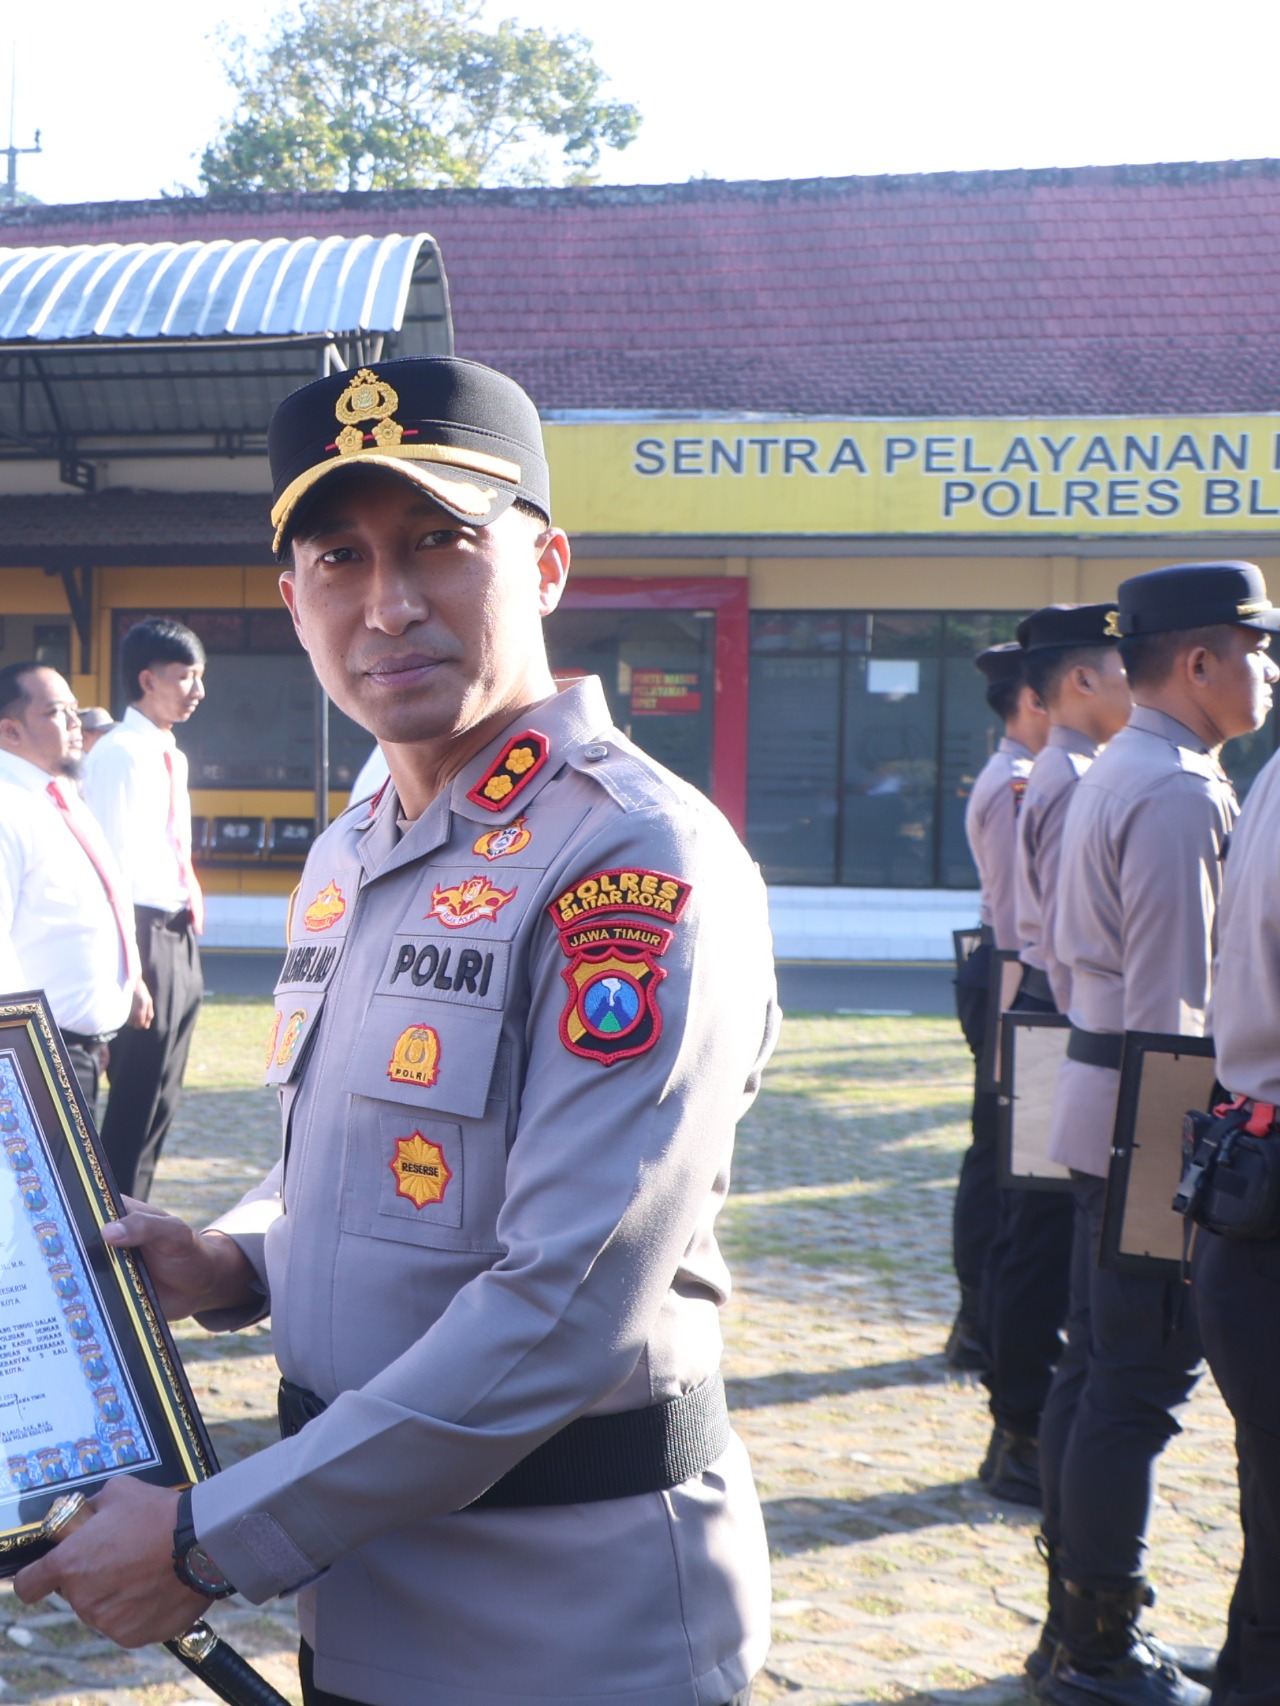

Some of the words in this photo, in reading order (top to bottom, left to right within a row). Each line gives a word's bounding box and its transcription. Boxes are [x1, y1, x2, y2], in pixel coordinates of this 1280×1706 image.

[634, 437, 868, 476] SENTRA
[884, 434, 1249, 475] PELAYANAN
[943, 480, 1181, 518] POLRES
[559, 873, 679, 911] POLRES
[561, 891, 623, 922] BLITAR
[626, 890, 673, 913] KOTA
[570, 928, 610, 947] JAWA
[613, 928, 661, 946] TIMUR
[389, 944, 494, 997] POLRI
[395, 1067, 427, 1082] POLRI
[401, 1162, 440, 1178] RESERSE
[0, 1297, 20, 1307] KOTA
[34, 1316, 57, 1326] DALAM
